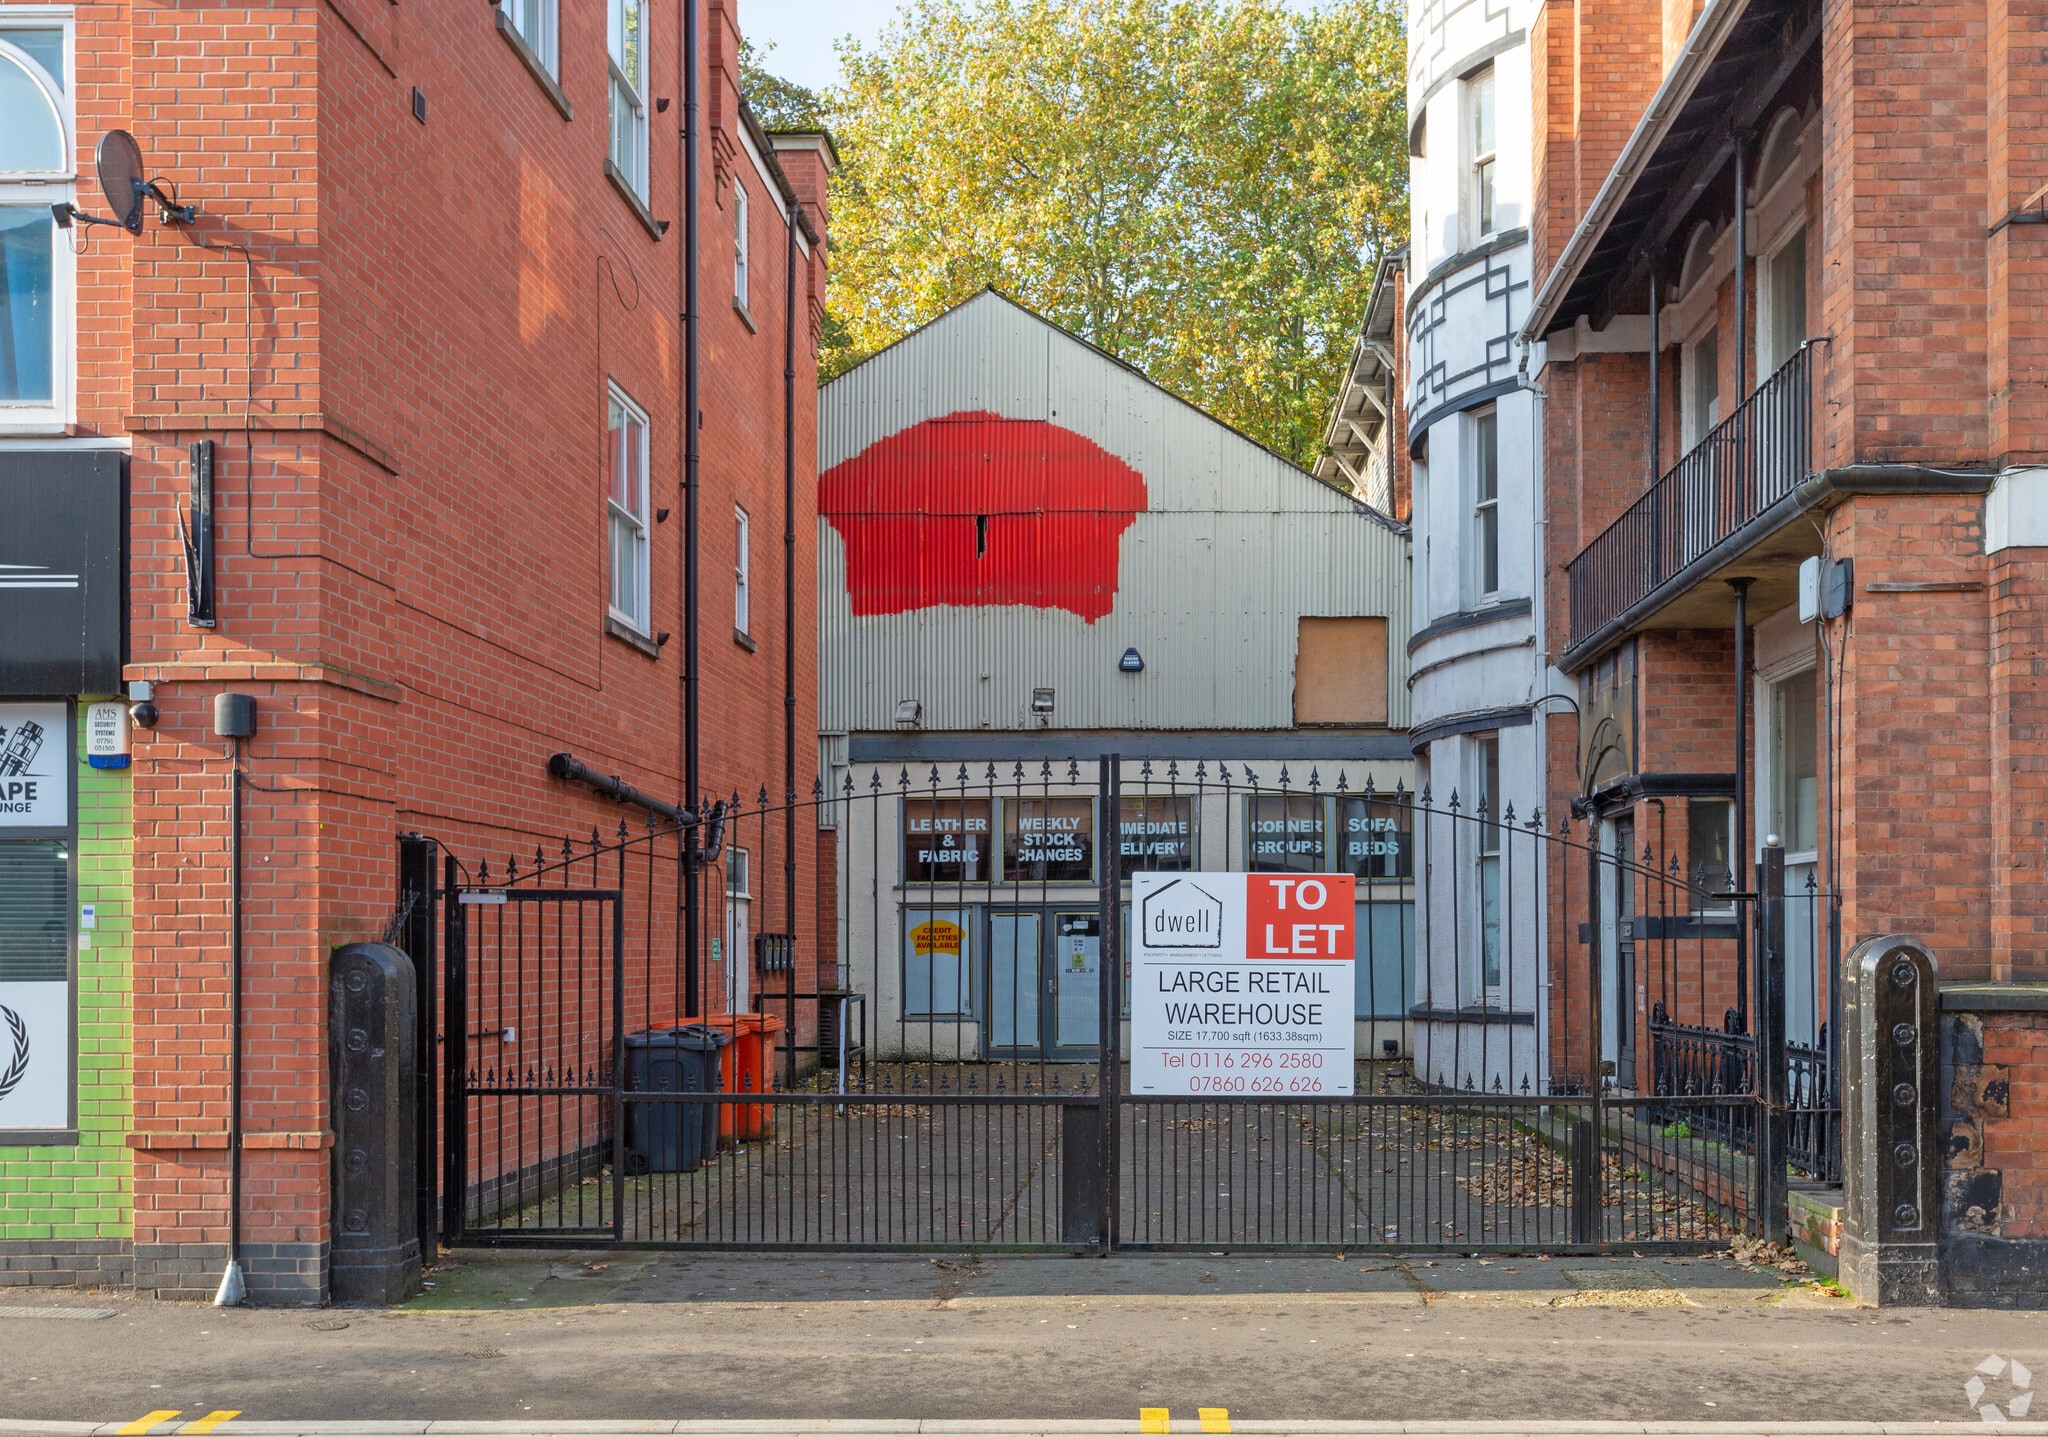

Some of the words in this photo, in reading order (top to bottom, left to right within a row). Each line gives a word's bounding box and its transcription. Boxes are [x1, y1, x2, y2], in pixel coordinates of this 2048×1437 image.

[95, 708, 117, 719] AMS
[94, 729, 116, 737] SYSTEMS
[0, 802, 32, 813] NGE
[910, 818, 987, 832] LEATHER
[1019, 817, 1081, 831] WEEKLY
[1119, 821, 1188, 835] MEDIATE
[1251, 820, 1323, 833] CORNER
[1348, 817, 1398, 832] SOFA
[942, 834, 956, 847] &
[1023, 832, 1076, 846] STOCK
[1120, 842, 1185, 855] ELIVERY
[1252, 840, 1323, 854] GROUPS
[1349, 841, 1400, 856] BEDS
[918, 849, 980, 863] FABRIC
[1017, 848, 1083, 862] CHANGES
[1269, 880, 1328, 910] TO
[1155, 908, 1209, 933] dwell
[1265, 924, 1345, 954] LET
[1159, 970, 1240, 993] LARGE
[1249, 971, 1330, 994] RETAIL
[1165, 1003, 1323, 1025] WAREHOUSE
[1167, 1030, 1192, 1041] SIZE
[1196, 1031, 1230, 1042] 17,700
[1232, 1031, 1251, 1043] sqft
[1253, 1031, 1323, 1043] (1633.38sqm)
[1161, 1052, 1185, 1068] Tel
[1190, 1052, 1235, 1068] 0116
[1240, 1053, 1273, 1068] 296
[1279, 1053, 1323, 1069] 2580
[1189, 1076, 1245, 1092] 07860
[1250, 1077, 1284, 1092] 626
[1289, 1077, 1323, 1092] 626
